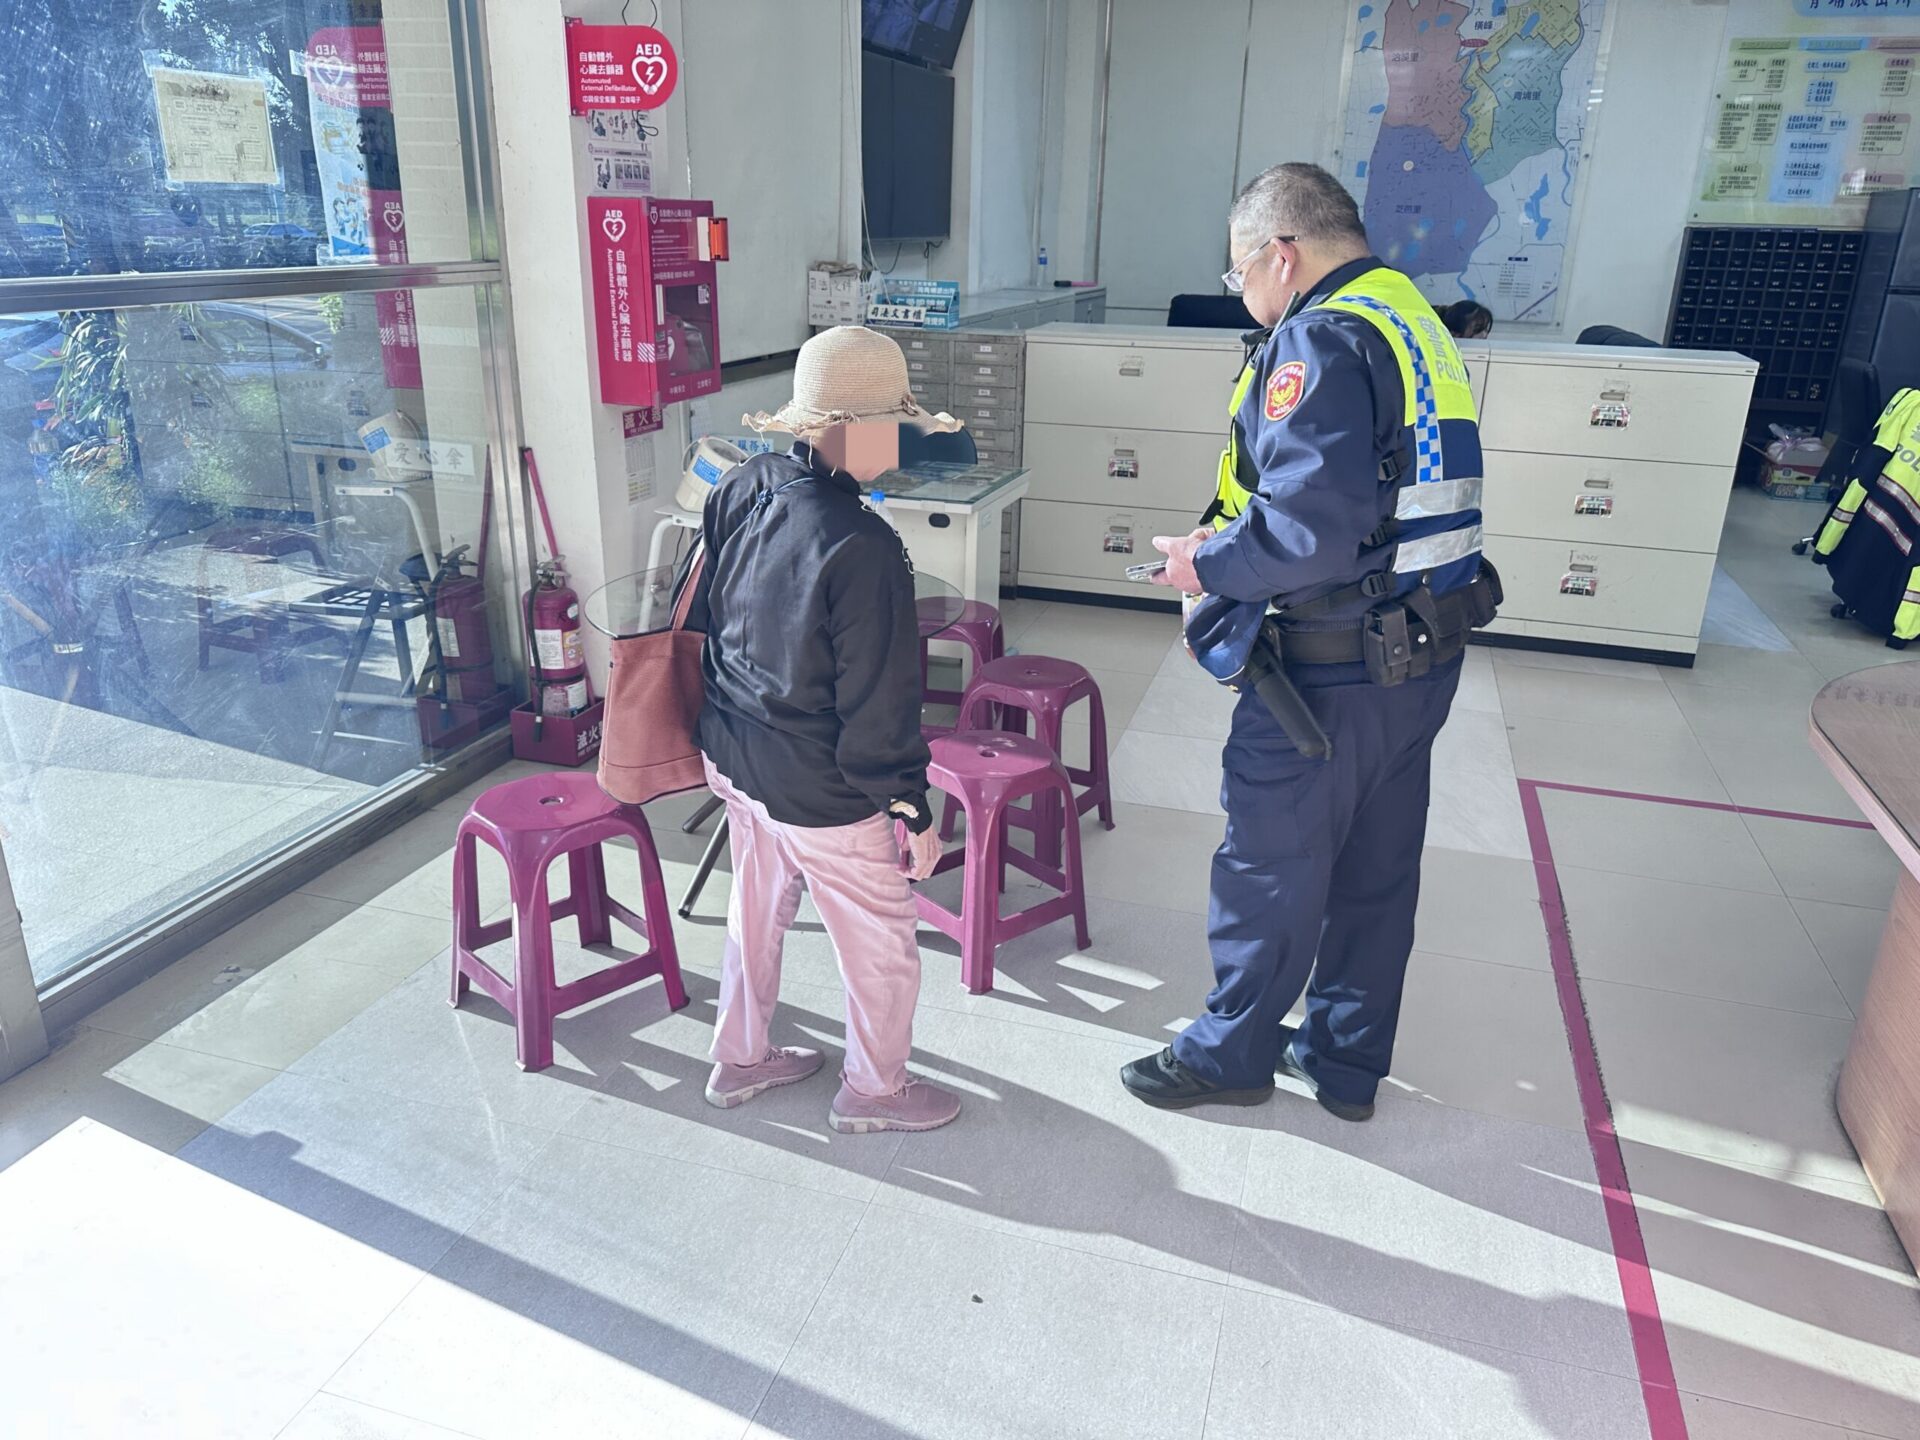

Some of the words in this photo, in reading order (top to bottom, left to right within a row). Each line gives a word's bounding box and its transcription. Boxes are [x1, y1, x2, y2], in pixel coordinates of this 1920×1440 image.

[636, 43, 662, 55] AED
[579, 51, 614, 62] 自動體外
[605, 209, 623, 218] AED
[616, 249, 632, 362] 自動體外心臟去顫器
[577, 720, 604, 751] 滅火
